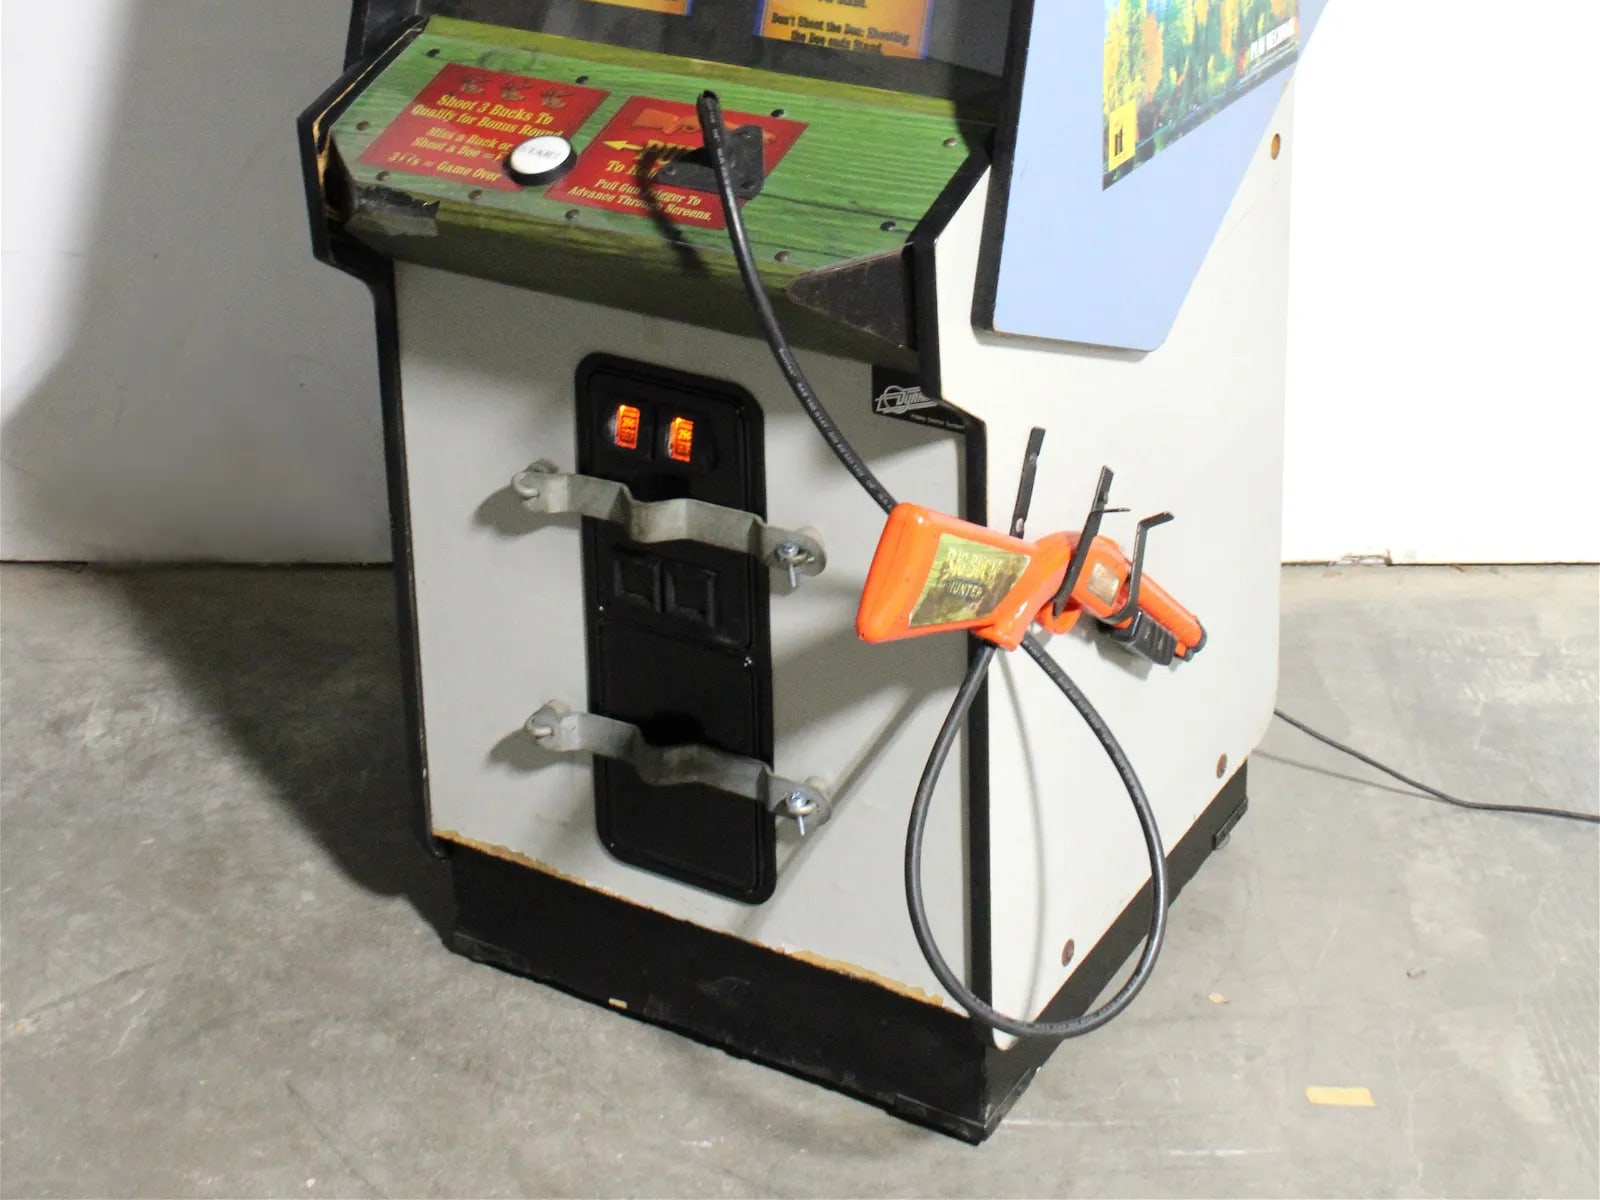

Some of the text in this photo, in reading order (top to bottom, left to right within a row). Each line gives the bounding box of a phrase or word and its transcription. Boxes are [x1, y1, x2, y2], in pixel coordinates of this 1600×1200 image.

[411, 103, 456, 123] Qualify
[456, 112, 476, 126] for
[477, 115, 517, 133] Bonus
[436, 94, 554, 126] Shoot 3 Bucks To
[410, 136, 447, 152] Shoot
[448, 143, 458, 153] a
[459, 145, 481, 159] Doe
[426, 127, 515, 152] Miss a Buck or
[436, 160, 473, 177] Game
[474, 168, 502, 182] Over
[606, 160, 626, 173] To
[567, 186, 616, 203] Advance
[594, 178, 620, 191] Pull
[618, 183, 641, 195] Gun
[687, 195, 703, 207] To
[947, 547, 969, 578] BIG
